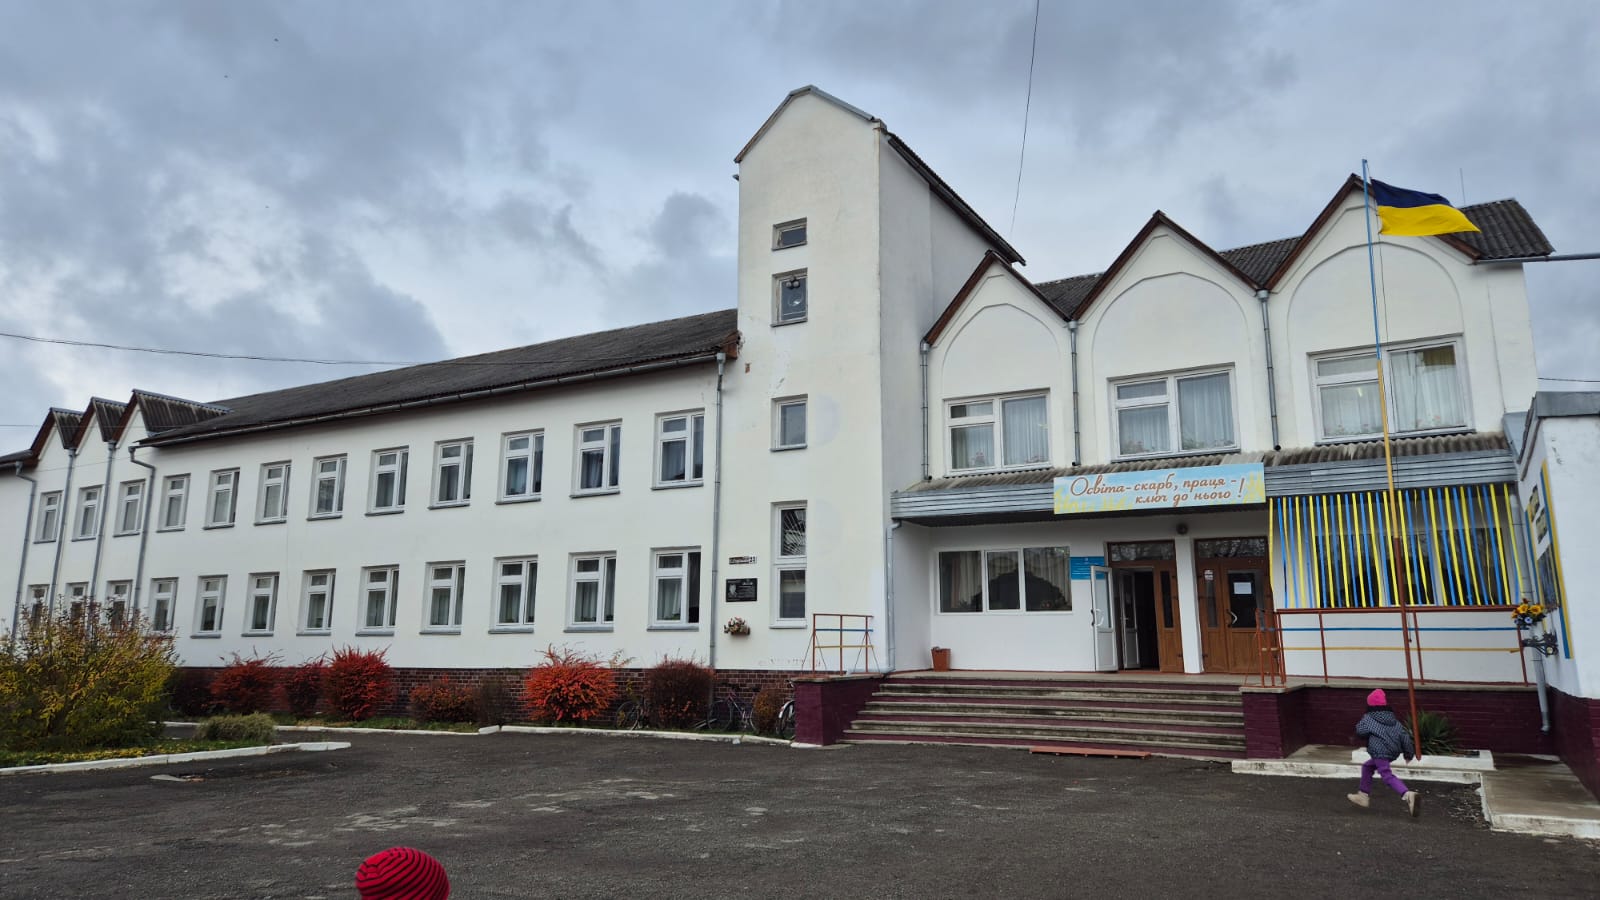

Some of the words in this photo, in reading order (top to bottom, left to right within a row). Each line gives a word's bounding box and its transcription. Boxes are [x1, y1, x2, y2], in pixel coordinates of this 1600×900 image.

[1183, 478, 1226, 493] праця
[1135, 494, 1168, 504] ключ
[1173, 493, 1189, 507] до
